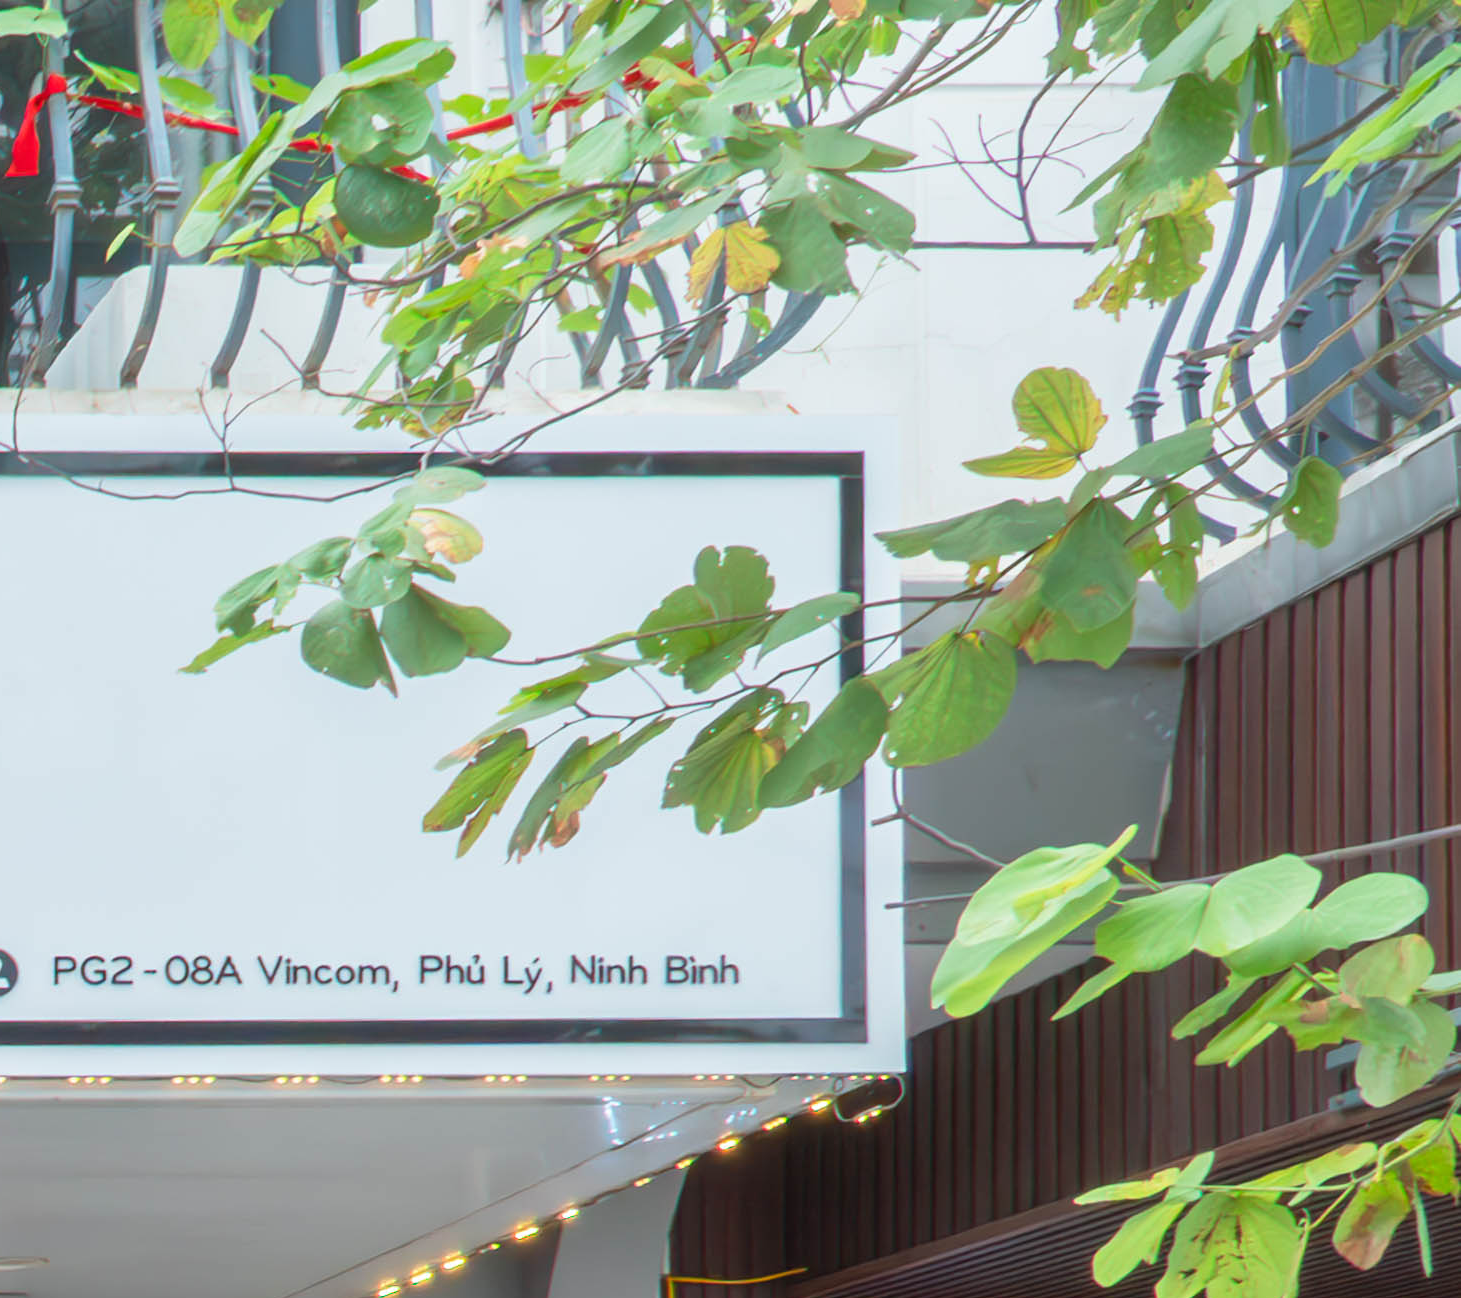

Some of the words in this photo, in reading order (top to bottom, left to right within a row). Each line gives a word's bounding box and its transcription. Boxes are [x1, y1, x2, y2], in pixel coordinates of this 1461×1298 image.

[257, 954, 400, 994] Vincom,
[419, 953, 486, 986] Phủ
[502, 954, 553, 994] Lý,
[570, 954, 647, 986] Ninh
[665, 954, 740, 986] Bình
